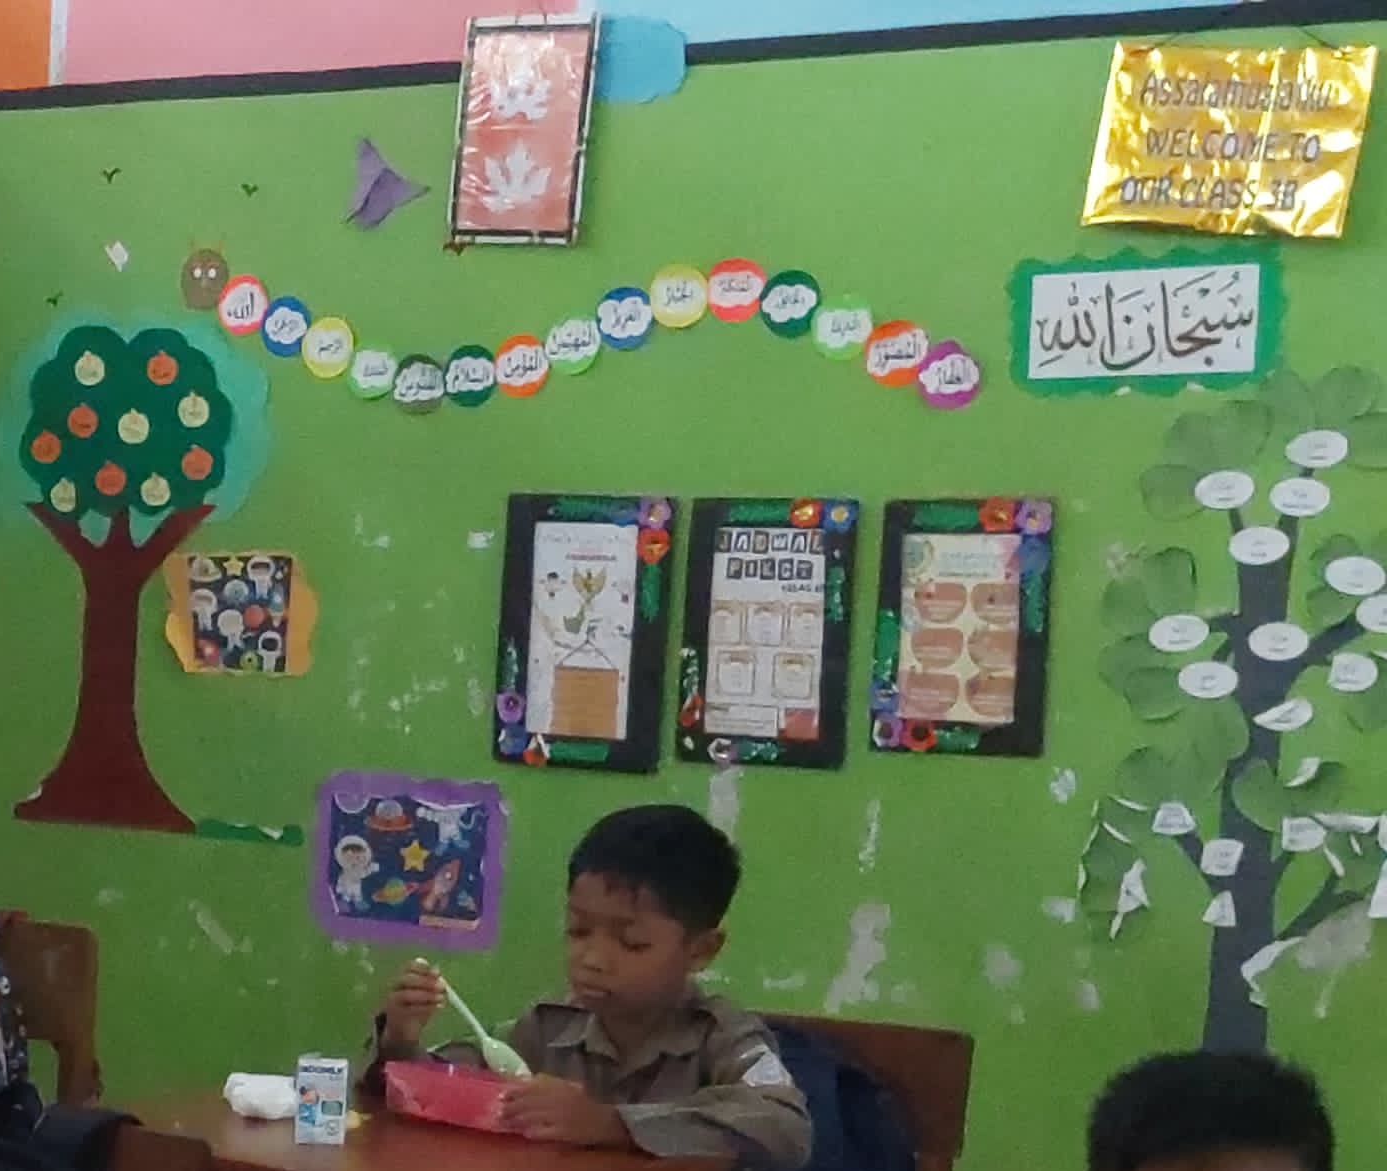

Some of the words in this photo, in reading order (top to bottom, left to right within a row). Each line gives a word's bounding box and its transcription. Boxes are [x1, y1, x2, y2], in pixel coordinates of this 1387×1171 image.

[1147, 127, 1276, 162] WELCOME
[1287, 132, 1321, 162] TO
[1120, 176, 1172, 207] OUR
[1179, 177, 1258, 209] CLASS
[1266, 179, 1299, 211] 3B
[717, 530, 826, 553] JADWAL
